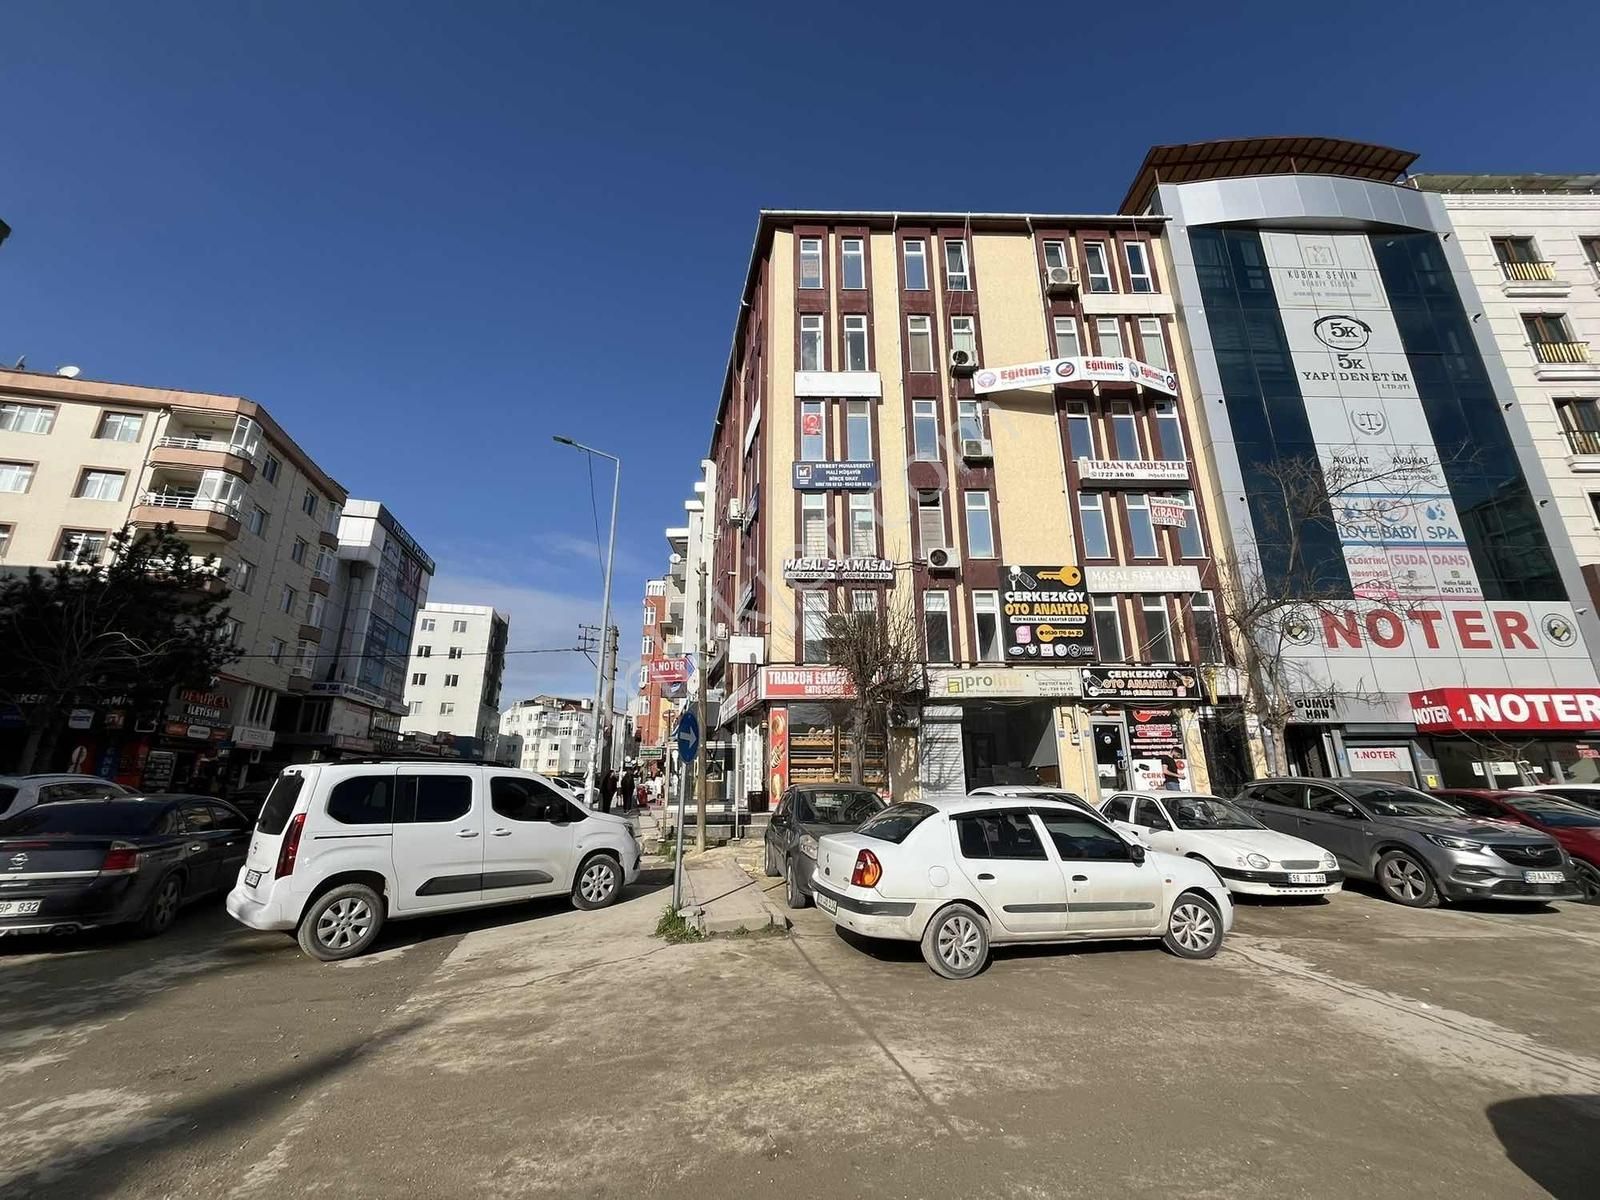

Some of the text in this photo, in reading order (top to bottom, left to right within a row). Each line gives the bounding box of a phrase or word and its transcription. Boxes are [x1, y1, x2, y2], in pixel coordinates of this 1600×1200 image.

[1302, 370, 1409, 382] YAPI DENETİM
[1090, 461, 1185, 473] TURAN KARDEŞLER
[1337, 525, 1459, 540] LOVE BABY SPA
[784, 559, 894, 571] MASAL SPA MASAJ
[1004, 589, 1085, 604] ÇERKEZKÖY
[1004, 603, 1089, 615] OTO ANAHTAR
[1318, 608, 1539, 650] NOTER
[767, 671, 811, 685] TRABZON
[1107, 669, 1169, 679] ÇERKEZKÖY
[1103, 679, 1125, 688] OTO
[1305, 709, 1330, 719] HAN
[1412, 705, 1452, 725] NOTER
[1354, 751, 1397, 759] 1.NOTER
[17, 901, 39, 913] 832
